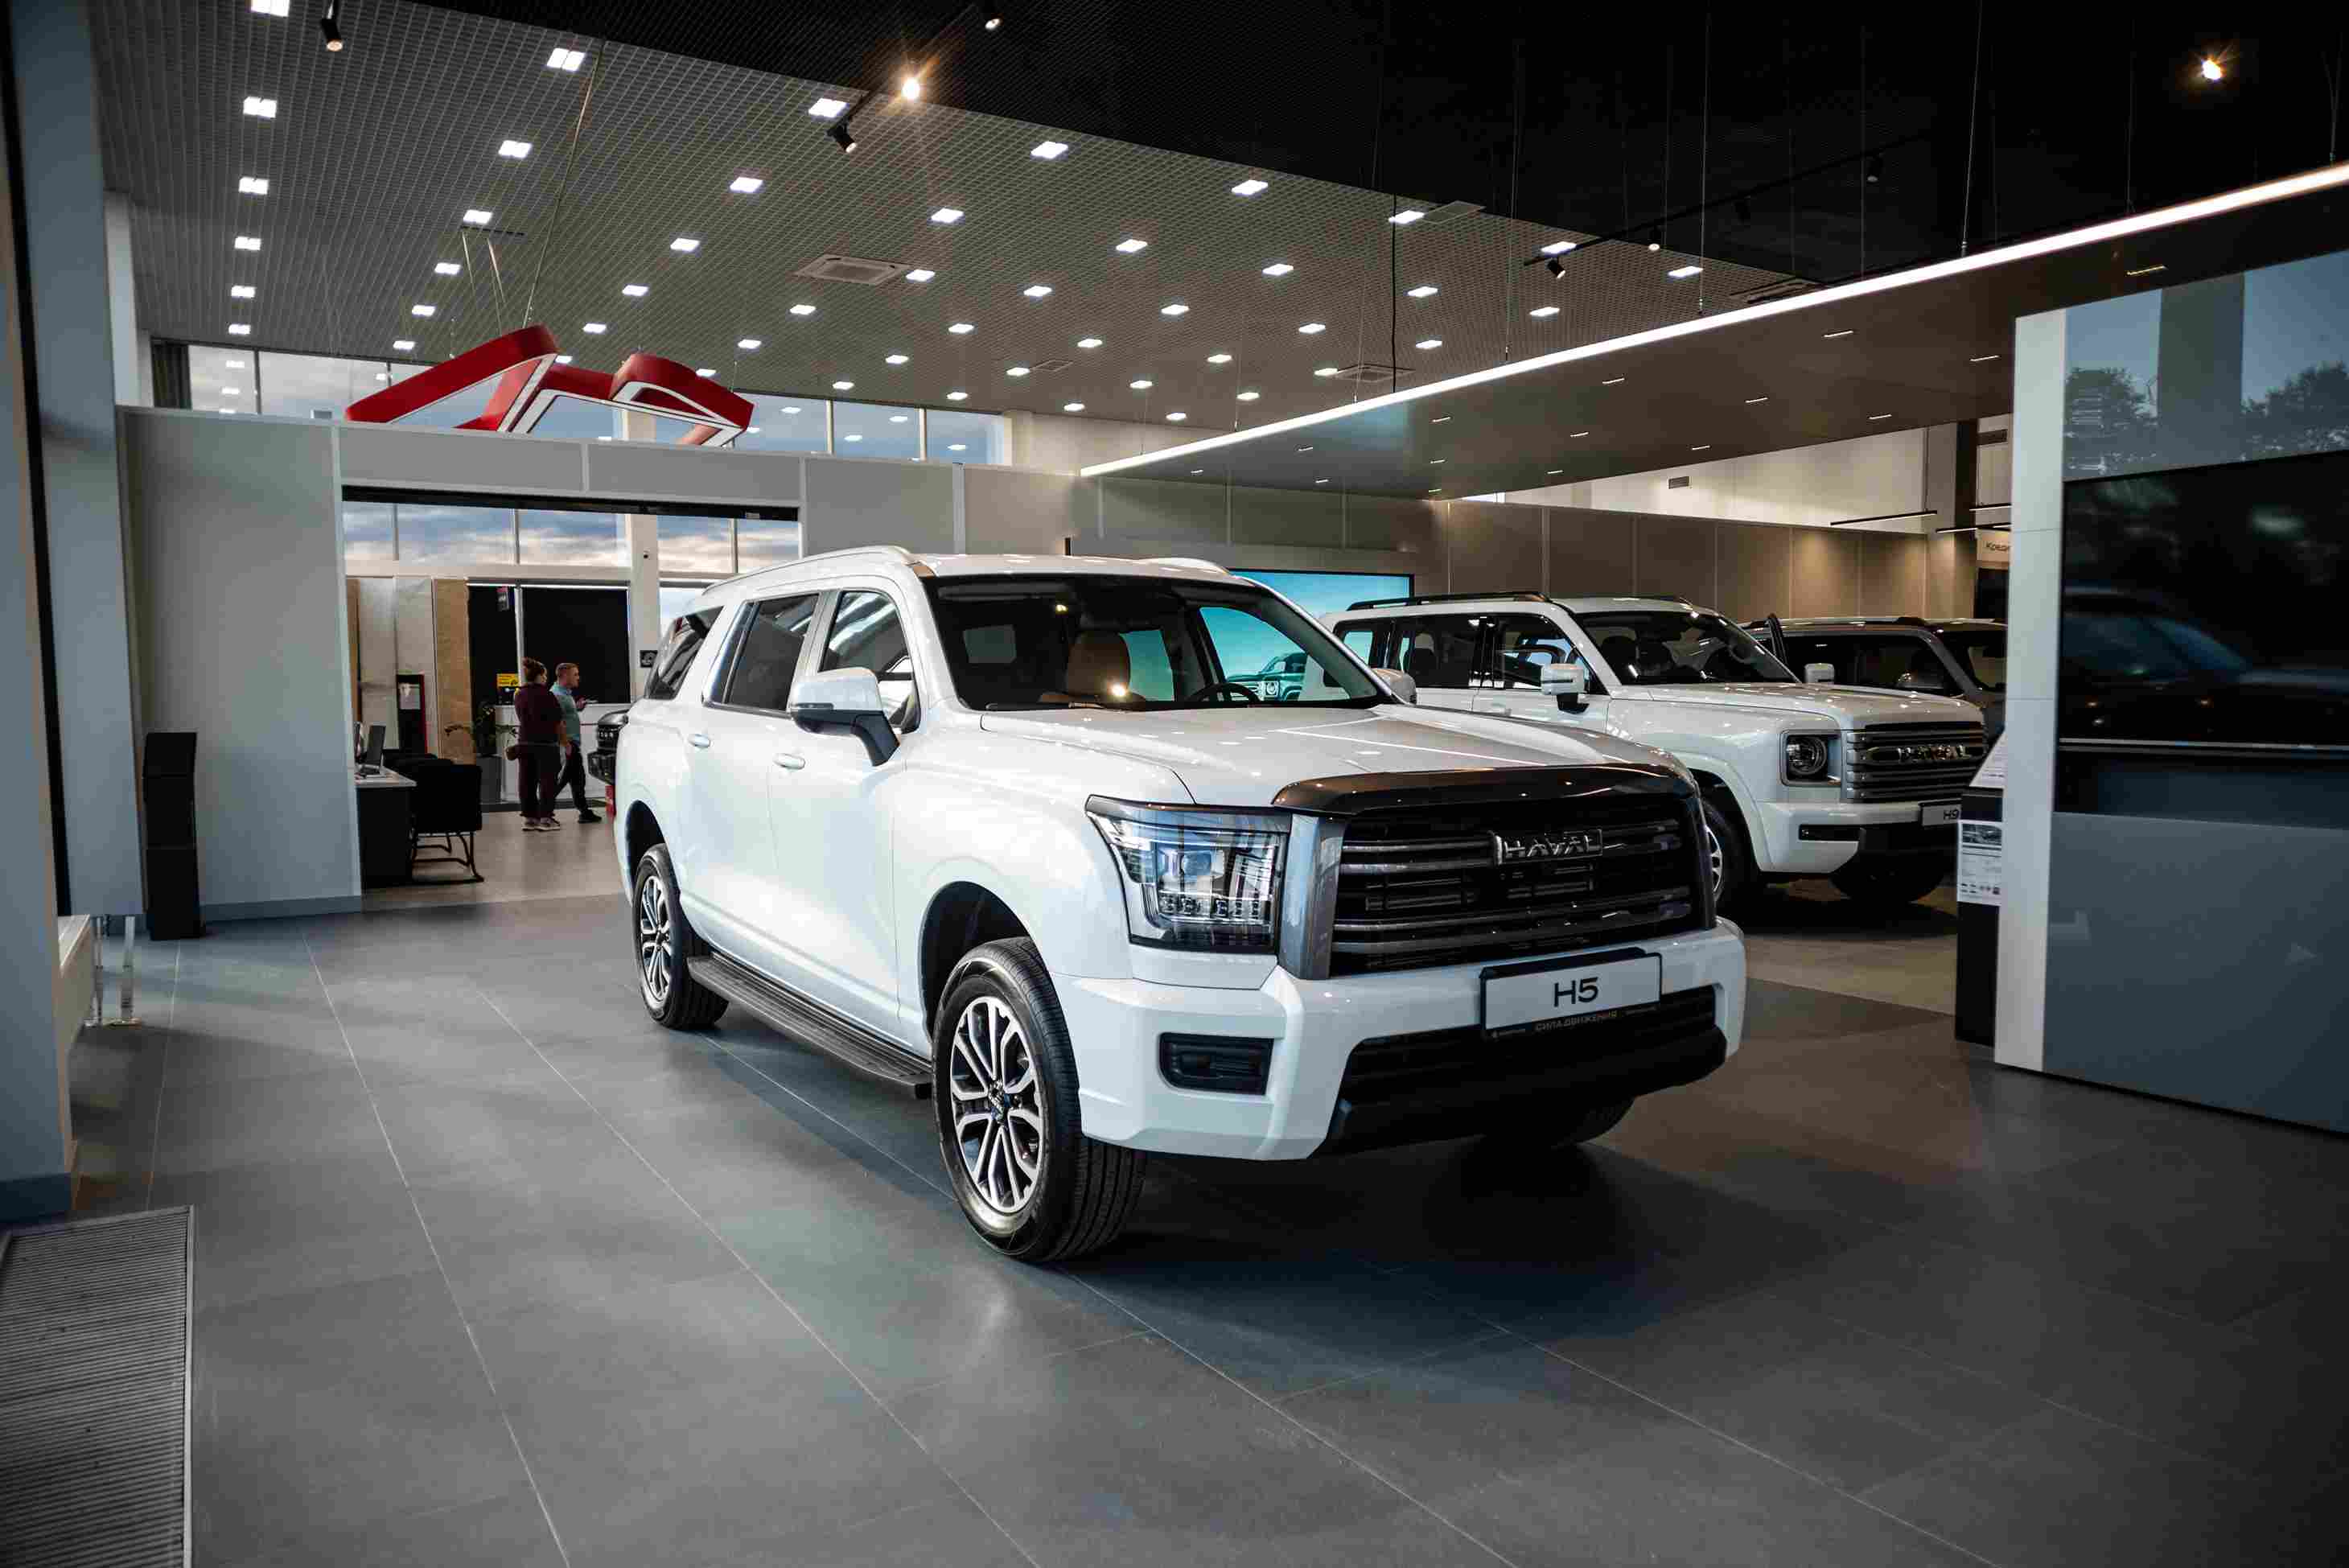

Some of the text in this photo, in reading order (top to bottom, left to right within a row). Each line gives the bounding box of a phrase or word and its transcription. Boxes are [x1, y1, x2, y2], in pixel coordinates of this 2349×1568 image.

[1985, 541, 2010, 552] Кред
[1503, 833, 1602, 858] HAVAL
[1553, 976, 1598, 1007] H5
[1536, 1019, 1562, 1031] СИЛА
